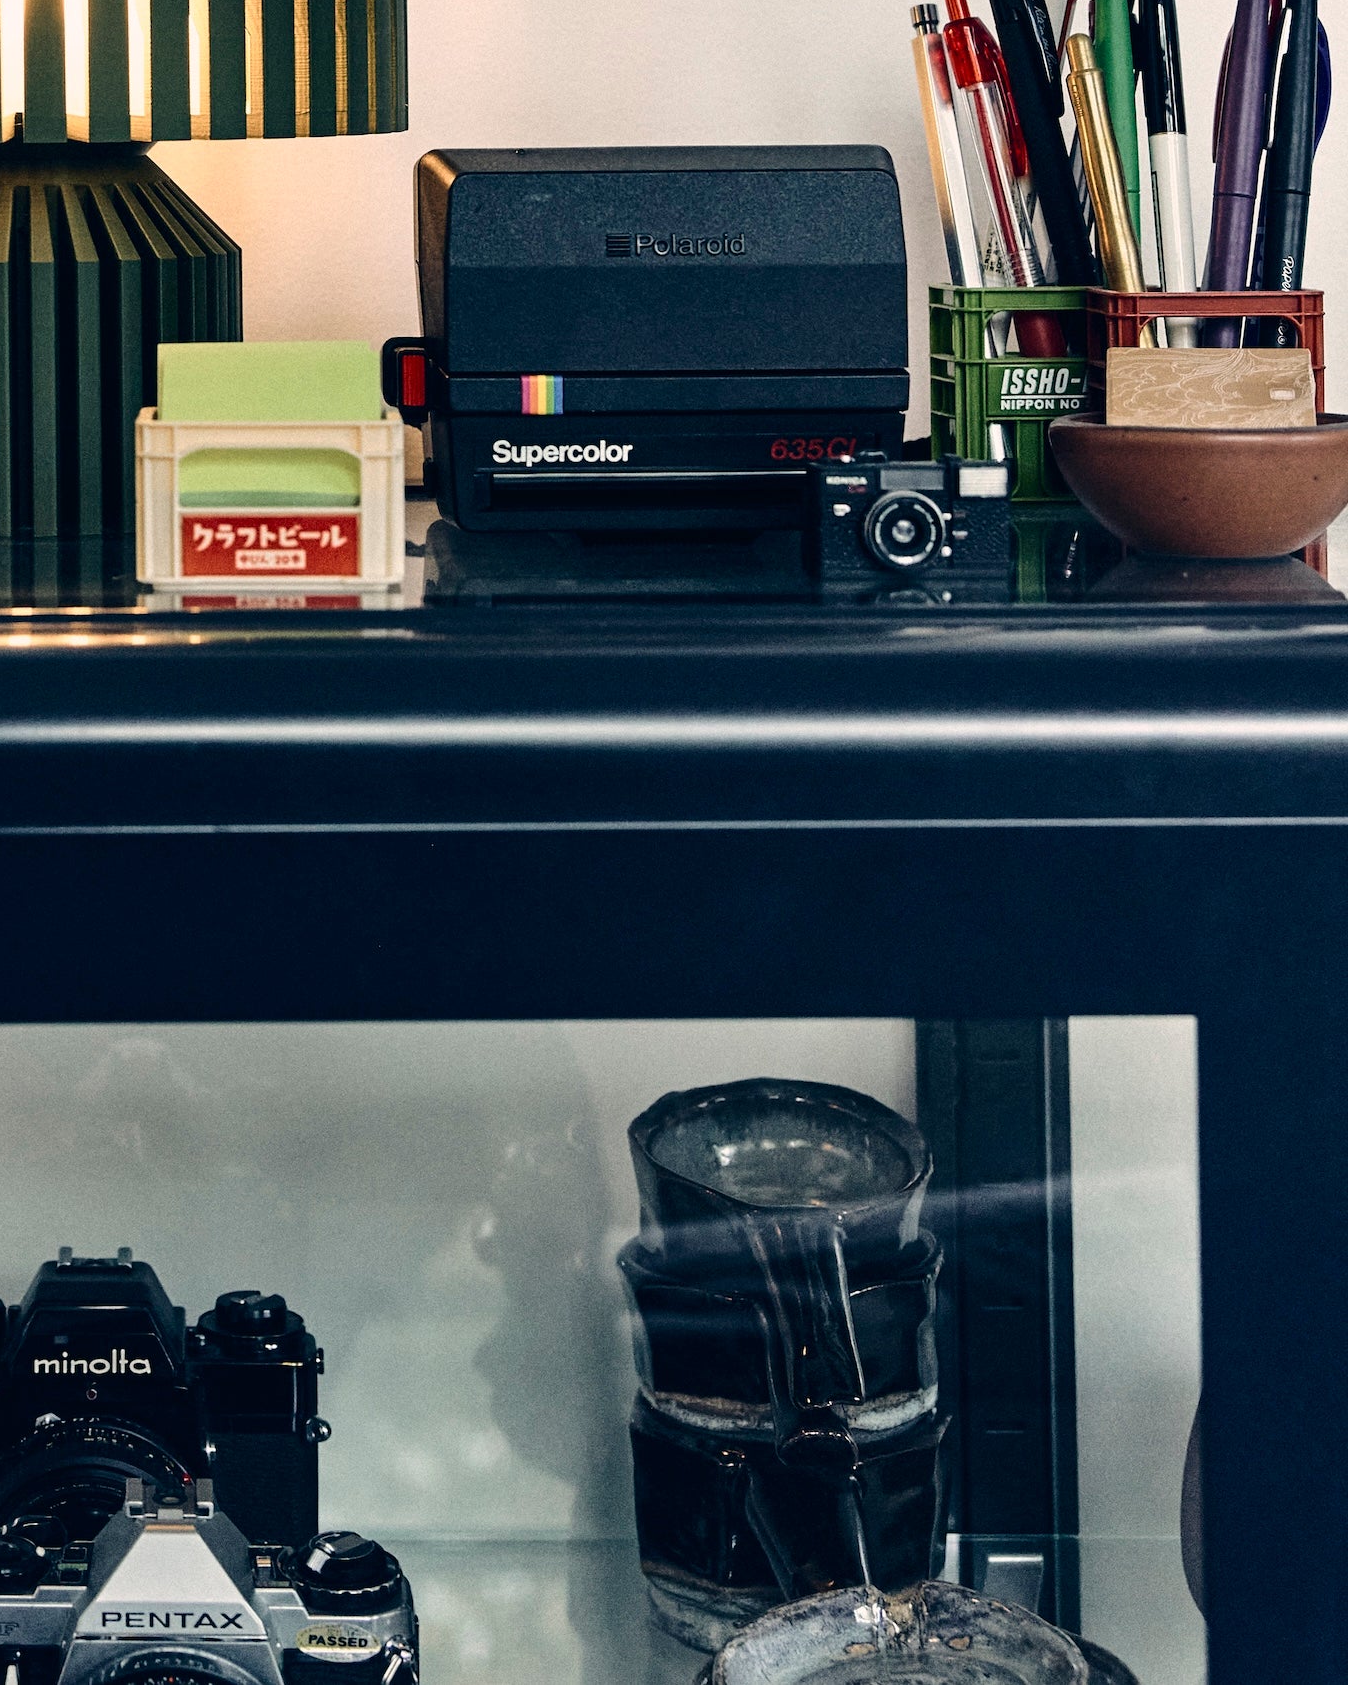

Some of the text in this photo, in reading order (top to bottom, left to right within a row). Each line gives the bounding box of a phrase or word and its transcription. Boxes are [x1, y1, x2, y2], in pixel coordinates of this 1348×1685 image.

[636, 233, 746, 256] Polaroid
[1001, 368, 1088, 394] ISSHO-
[1000, 398, 1080, 411] NIPPON NO
[492, 439, 634, 467] Supercolor
[193, 523, 348, 552] クラフトビール
[34, 1348, 152, 1375] minolta
[102, 1612, 244, 1630] PENTAX
[308, 1634, 369, 1648] PASSED
